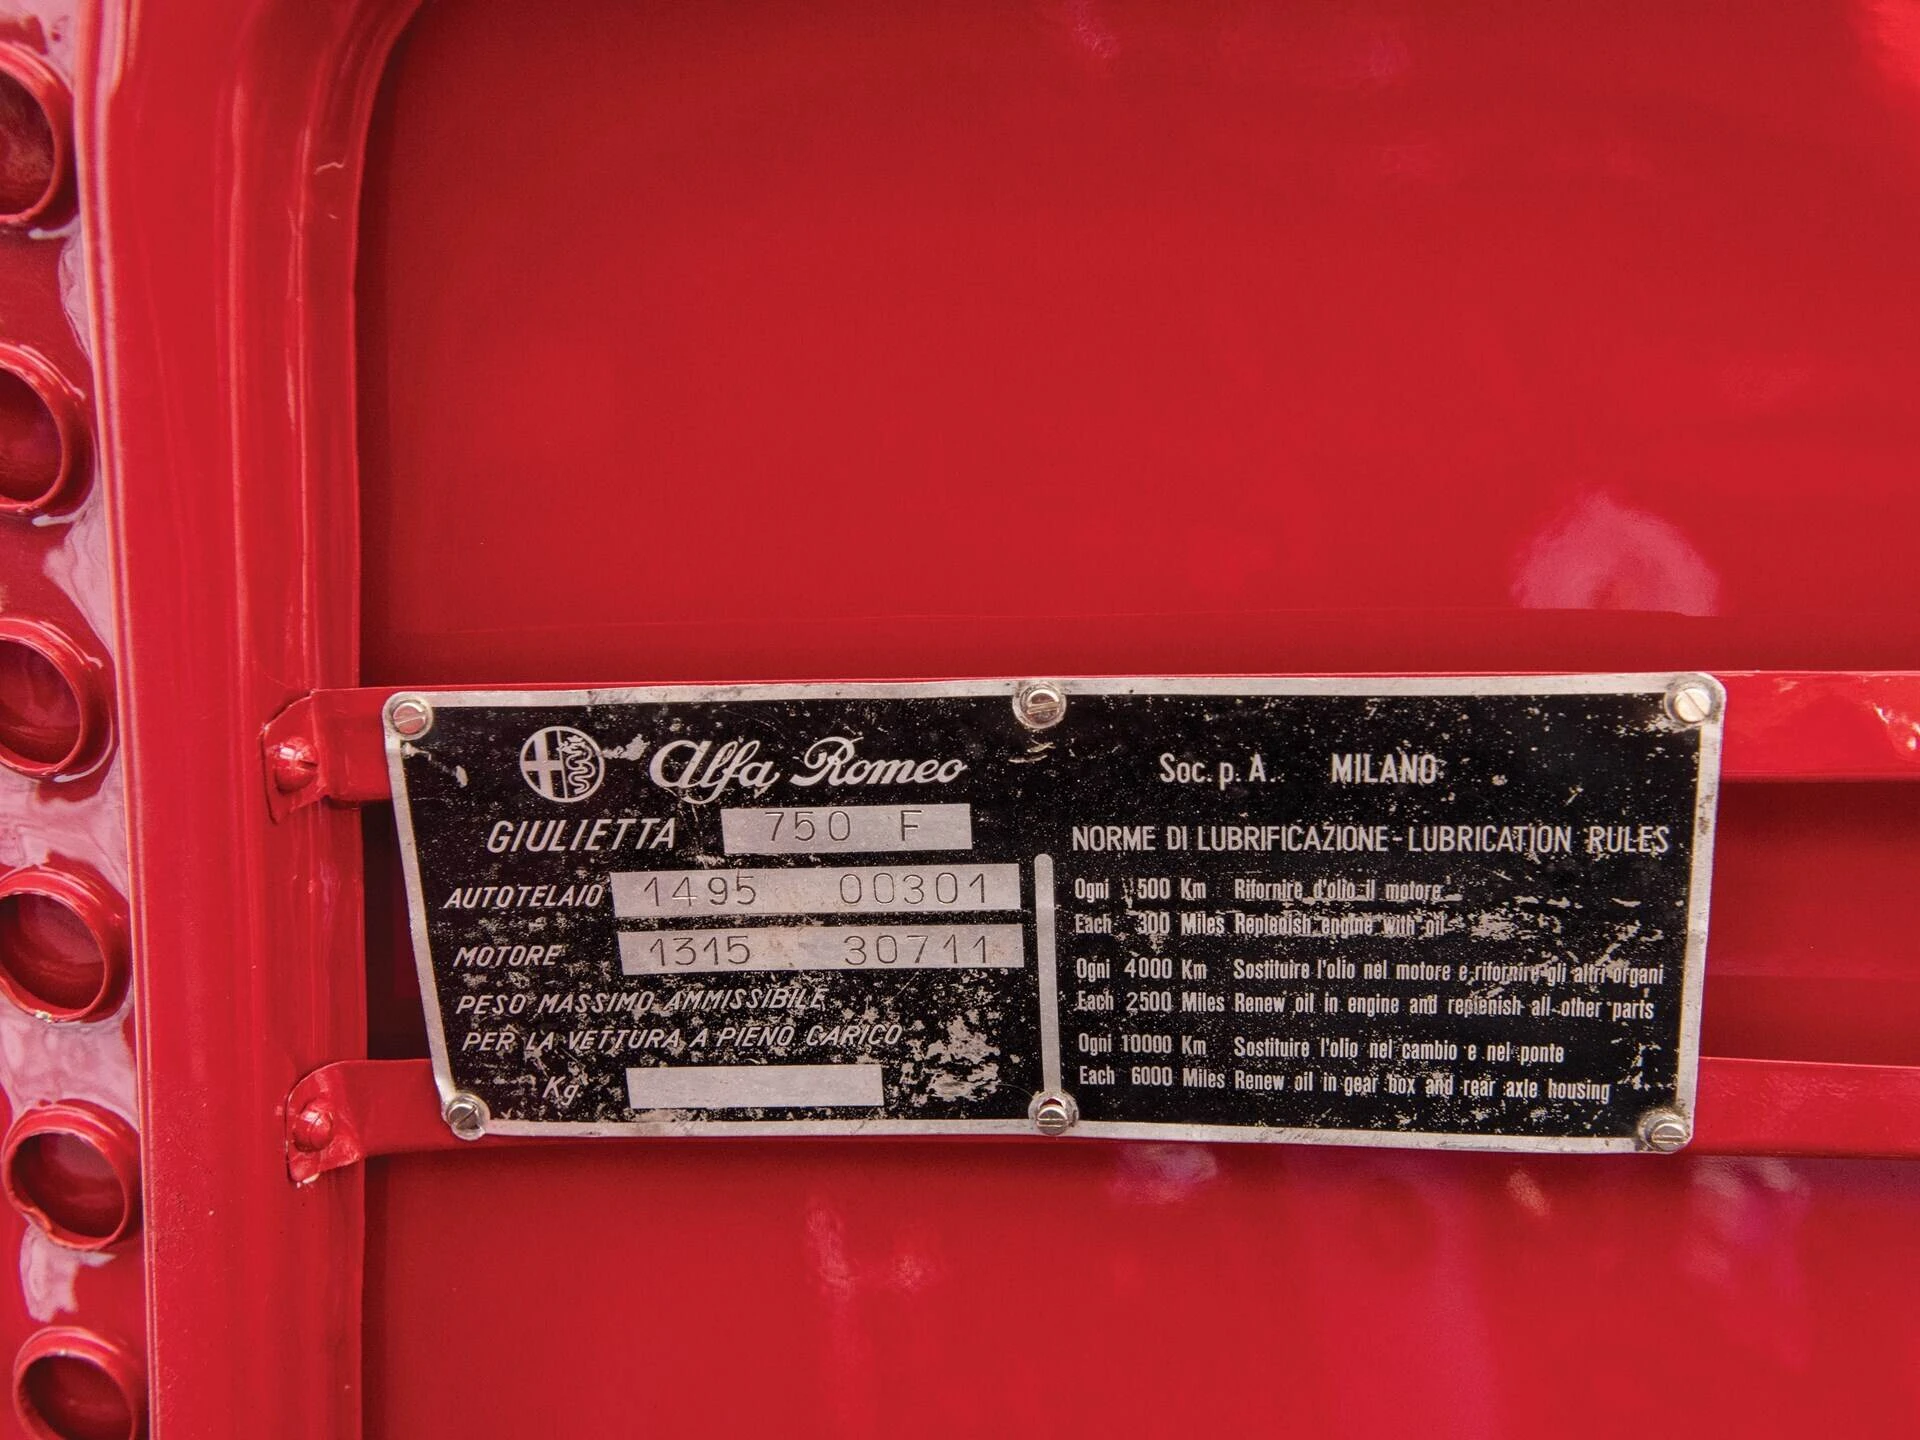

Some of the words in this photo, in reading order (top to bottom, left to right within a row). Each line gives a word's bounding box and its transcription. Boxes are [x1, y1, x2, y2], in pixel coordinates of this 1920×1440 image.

[649, 738, 780, 804] Alfa
[790, 736, 968, 787] Romeo
[1159, 752, 1212, 783] Soc.
[1331, 753, 1437, 784] MILANO
[487, 817, 676, 852] GIULIETTA
[764, 810, 852, 842] 750
[901, 809, 924, 841] F
[1072, 825, 1156, 851] NORME
[1167, 825, 1188, 851] DI
[1589, 826, 1671, 853] RULES
[444, 885, 602, 909] AUTOTELAIO
[643, 875, 757, 907] 1495
[838, 873, 987, 905] 00301
[1074, 878, 1109, 903] Ogni
[1137, 878, 1171, 899] 500
[1181, 878, 1206, 899] Km
[1235, 878, 1302, 900] Rifornire
[1312, 879, 1355, 900] d'olio
[1385, 881, 1442, 901] motore
[1075, 913, 1112, 934] Each
[1137, 912, 1170, 934] 300
[1181, 913, 1225, 934] Miles
[1235, 913, 1311, 937] Replenish
[1321, 914, 1372, 939] engine
[1383, 914, 1415, 936] with
[1425, 914, 1445, 936] oil
[453, 945, 563, 967] MOTORE
[649, 935, 751, 967] 1315
[844, 934, 989, 965] 30711
[1076, 958, 1110, 982] Ogni
[1123, 958, 1172, 979] 4000
[1182, 959, 1207, 980] Km
[1234, 959, 1310, 980] Sostituire
[1317, 960, 1355, 980] l'olio
[1364, 960, 1387, 980] nel
[1396, 962, 1450, 981] motore
[1459, 965, 1468, 981] e
[1475, 962, 1540, 983] rifornire
[1548, 963, 1566, 987] gli
[1573, 963, 1605, 983] altri
[1613, 964, 1664, 988] organi
[456, 994, 527, 1014] PESO
[538, 991, 654, 1013] MASSIMO
[664, 987, 829, 1010] AMMISSIBILE
[1077, 991, 1114, 1011] Each
[1126, 991, 1172, 1012] 2500
[1182, 992, 1225, 1012] Miles
[1235, 992, 1285, 1013] Renew
[1295, 992, 1314, 1013] oil
[1324, 993, 1338, 1013] in
[1348, 994, 1399, 1018] engine
[1409, 995, 1438, 1015] and
[1448, 996, 1521, 1018] replenish
[1531, 996, 1550, 1017] all
[1561, 997, 1602, 1018] other
[1612, 999, 1655, 1021] parts
[462, 1031, 515, 1051] PER
[526, 1031, 553, 1050] LA
[568, 1028, 681, 1050] VETTURA
[689, 1027, 708, 1048] A
[716, 1026, 795, 1048] PIENO
[806, 1024, 902, 1046] CARICO
[1078, 1033, 1112, 1055] Ogni
[1122, 1034, 1172, 1053] 10000
[1182, 1035, 1206, 1055] Km
[1234, 1036, 1310, 1057] Sostituire
[1321, 1037, 1358, 1058] l'olio
[1369, 1038, 1392, 1059] nel
[1402, 1040, 1457, 1060] cambio
[1468, 1044, 1477, 1060] e
[1487, 1042, 1510, 1061] nel
[1520, 1043, 1565, 1065] ponte
[1080, 1066, 1115, 1085] Each
[1131, 1067, 1172, 1086] 6000
[1183, 1069, 1225, 1089] Miles
[1235, 1070, 1285, 1090] Renew
[1294, 1071, 1313, 1091] oil
[1323, 1072, 1337, 1091] in
[1344, 1075, 1378, 1096] gear
[1388, 1073, 1415, 1094] box
[1425, 1075, 1453, 1095] and
[1463, 1078, 1496, 1097] rear
[1506, 1077, 1538, 1098] axle
[1548, 1078, 1610, 1104] housing
